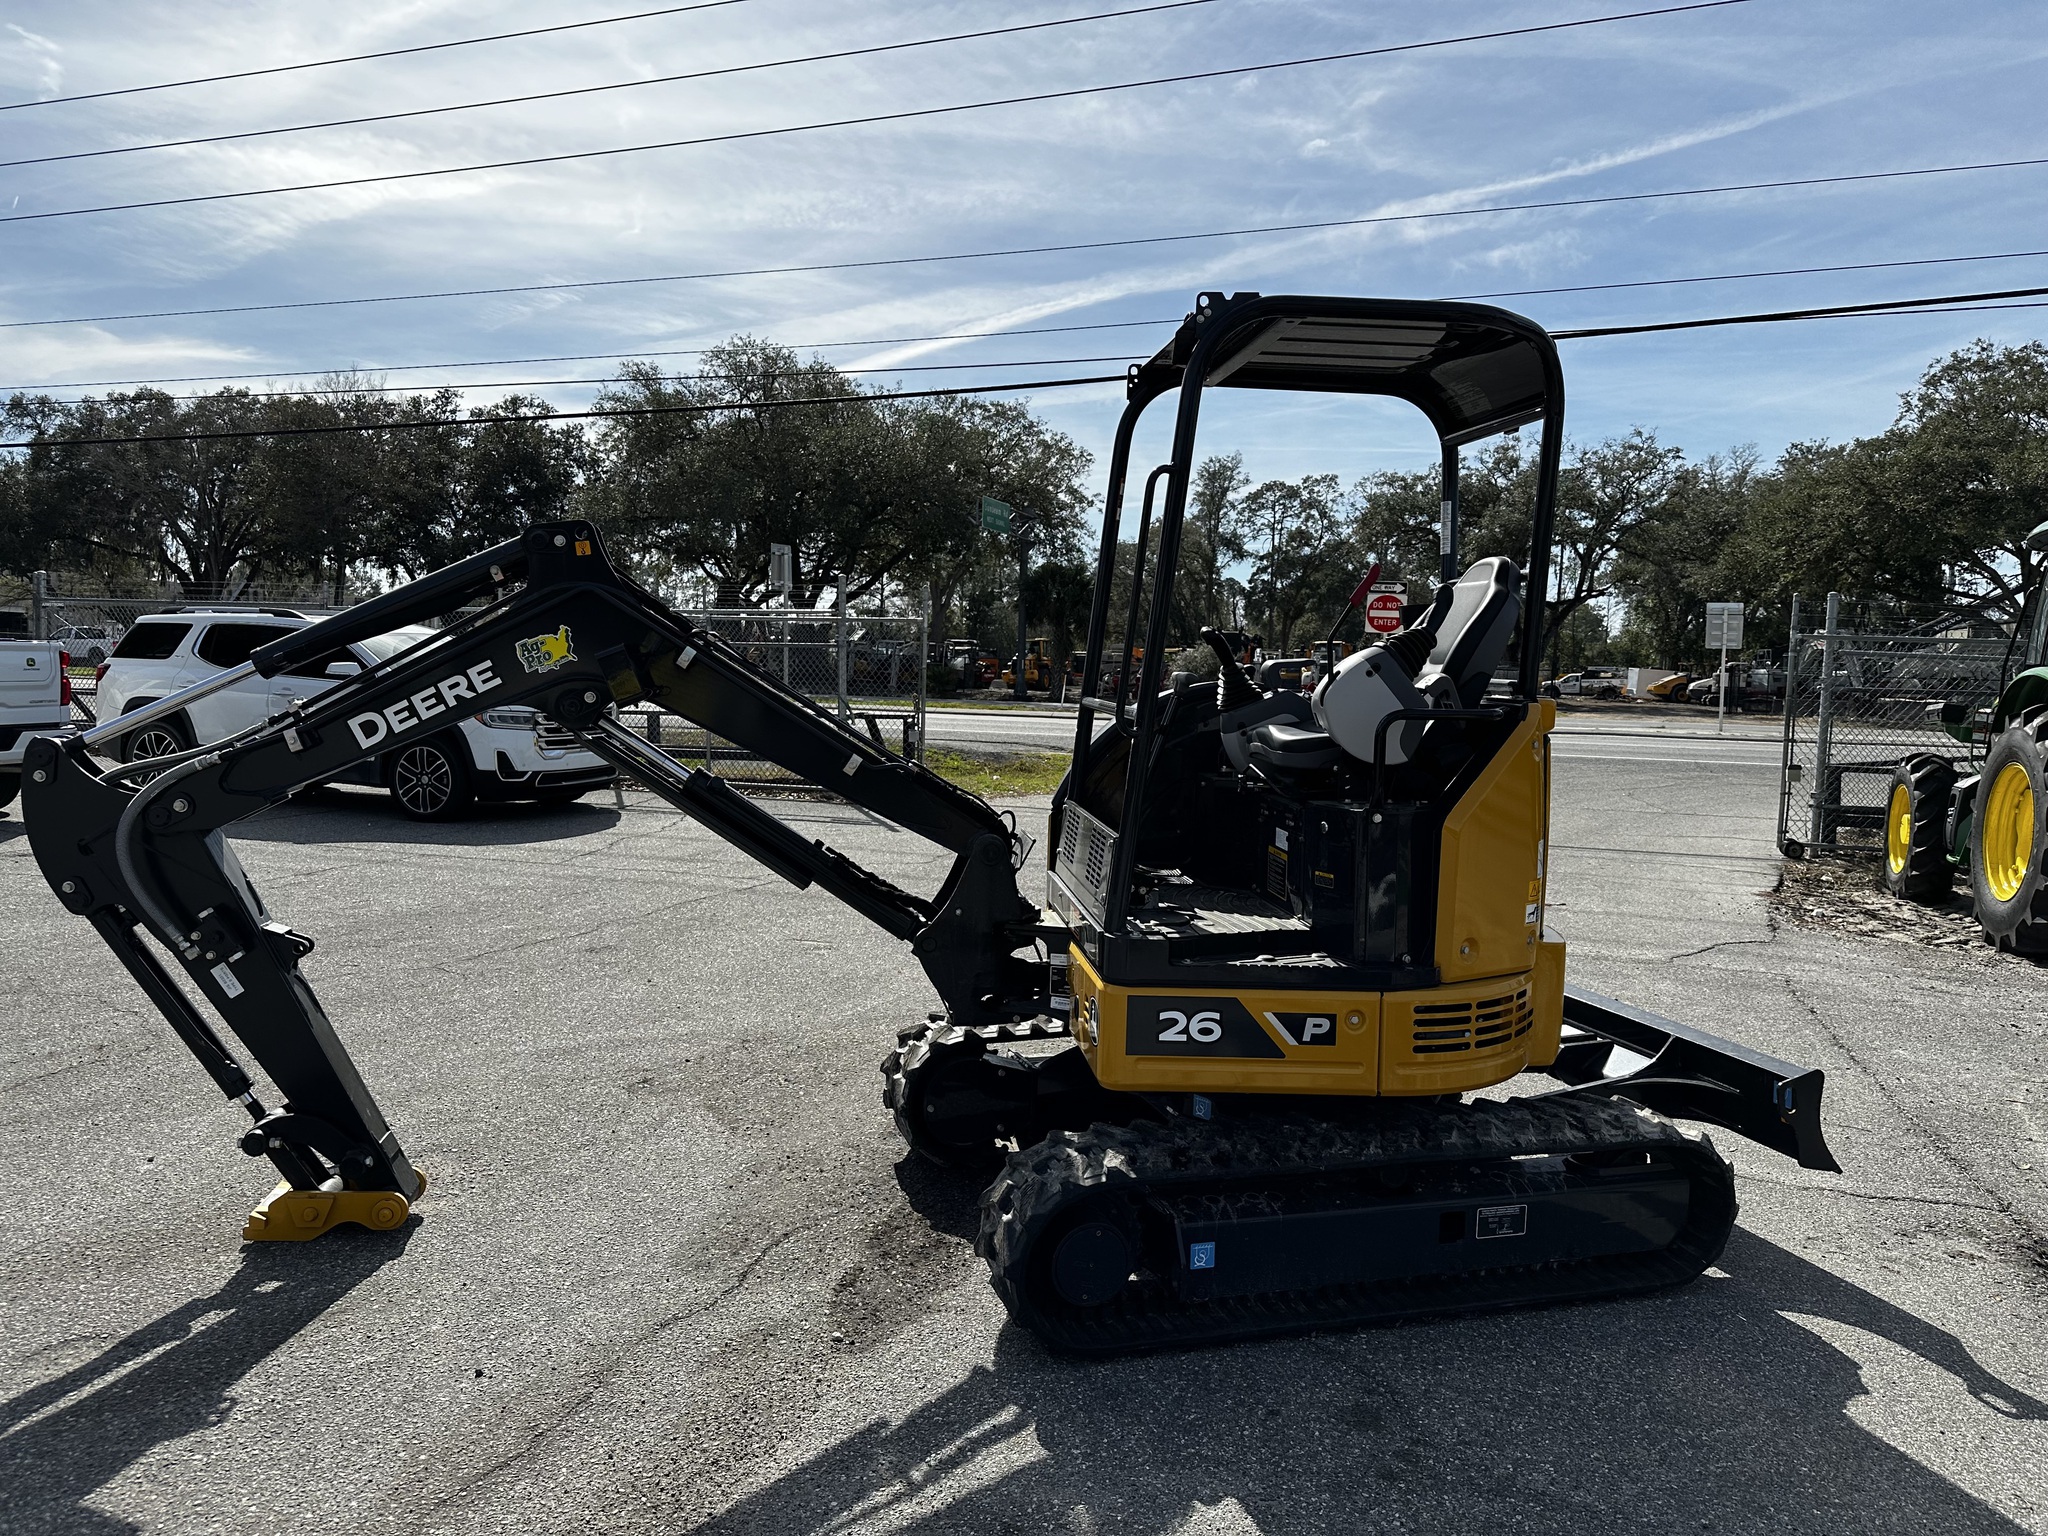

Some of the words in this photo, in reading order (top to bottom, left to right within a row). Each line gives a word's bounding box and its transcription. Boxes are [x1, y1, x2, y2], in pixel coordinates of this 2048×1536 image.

[1934, 615, 1962, 630] VOLVO
[524, 651, 552, 669] Pro
[347, 659, 503, 750] DEERE
[1157, 1010, 1222, 1043] 26
[1302, 1017, 1331, 1042] P
